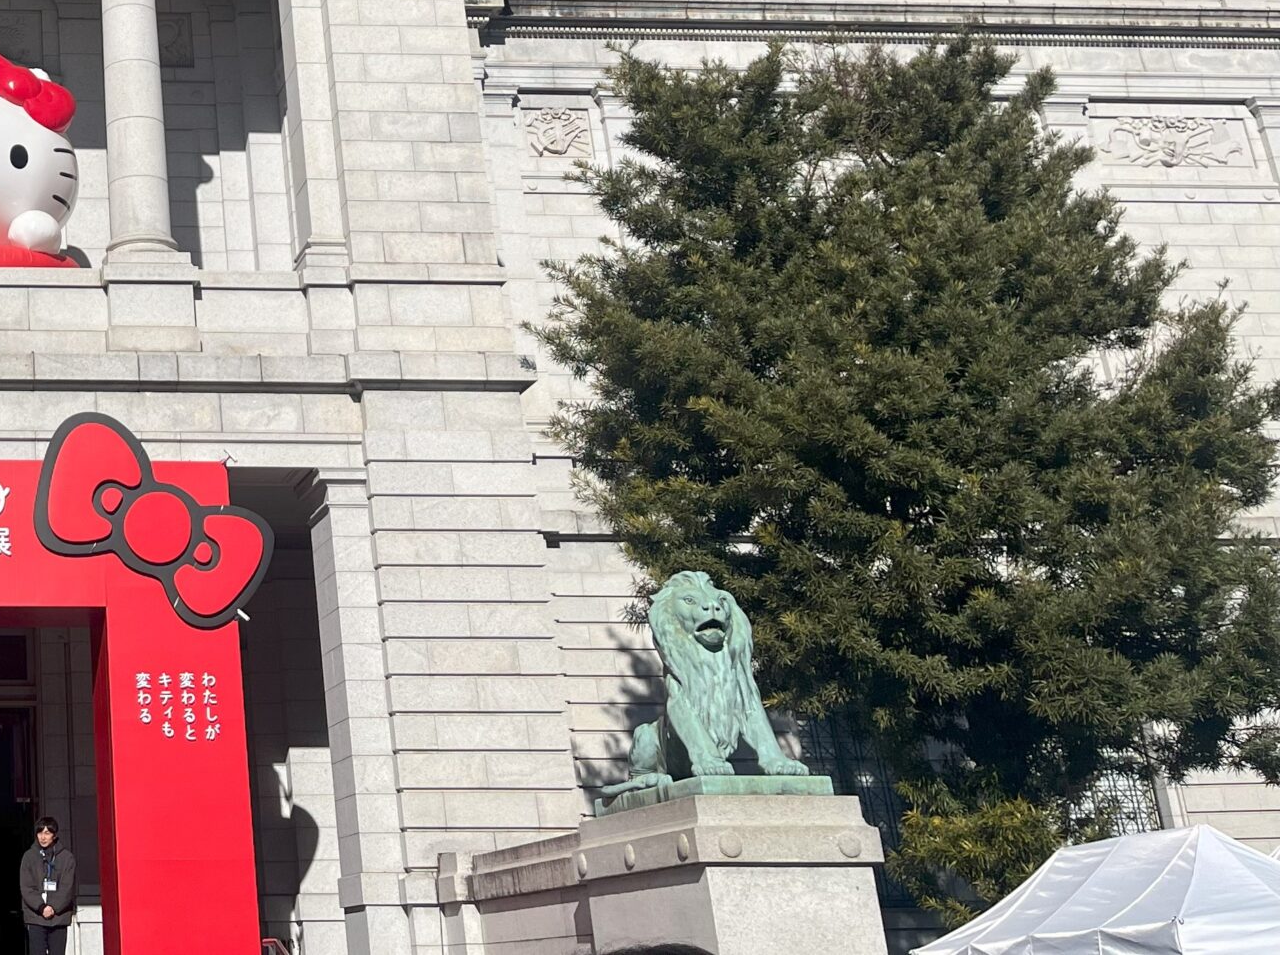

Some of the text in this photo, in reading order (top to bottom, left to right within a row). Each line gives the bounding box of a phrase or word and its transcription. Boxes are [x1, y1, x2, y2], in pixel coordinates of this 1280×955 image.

[135, 672, 152, 724] 変わる
[158, 672, 175, 738] キティも
[179, 672, 197, 741] 変わると
[201, 672, 221, 741] わたしが
